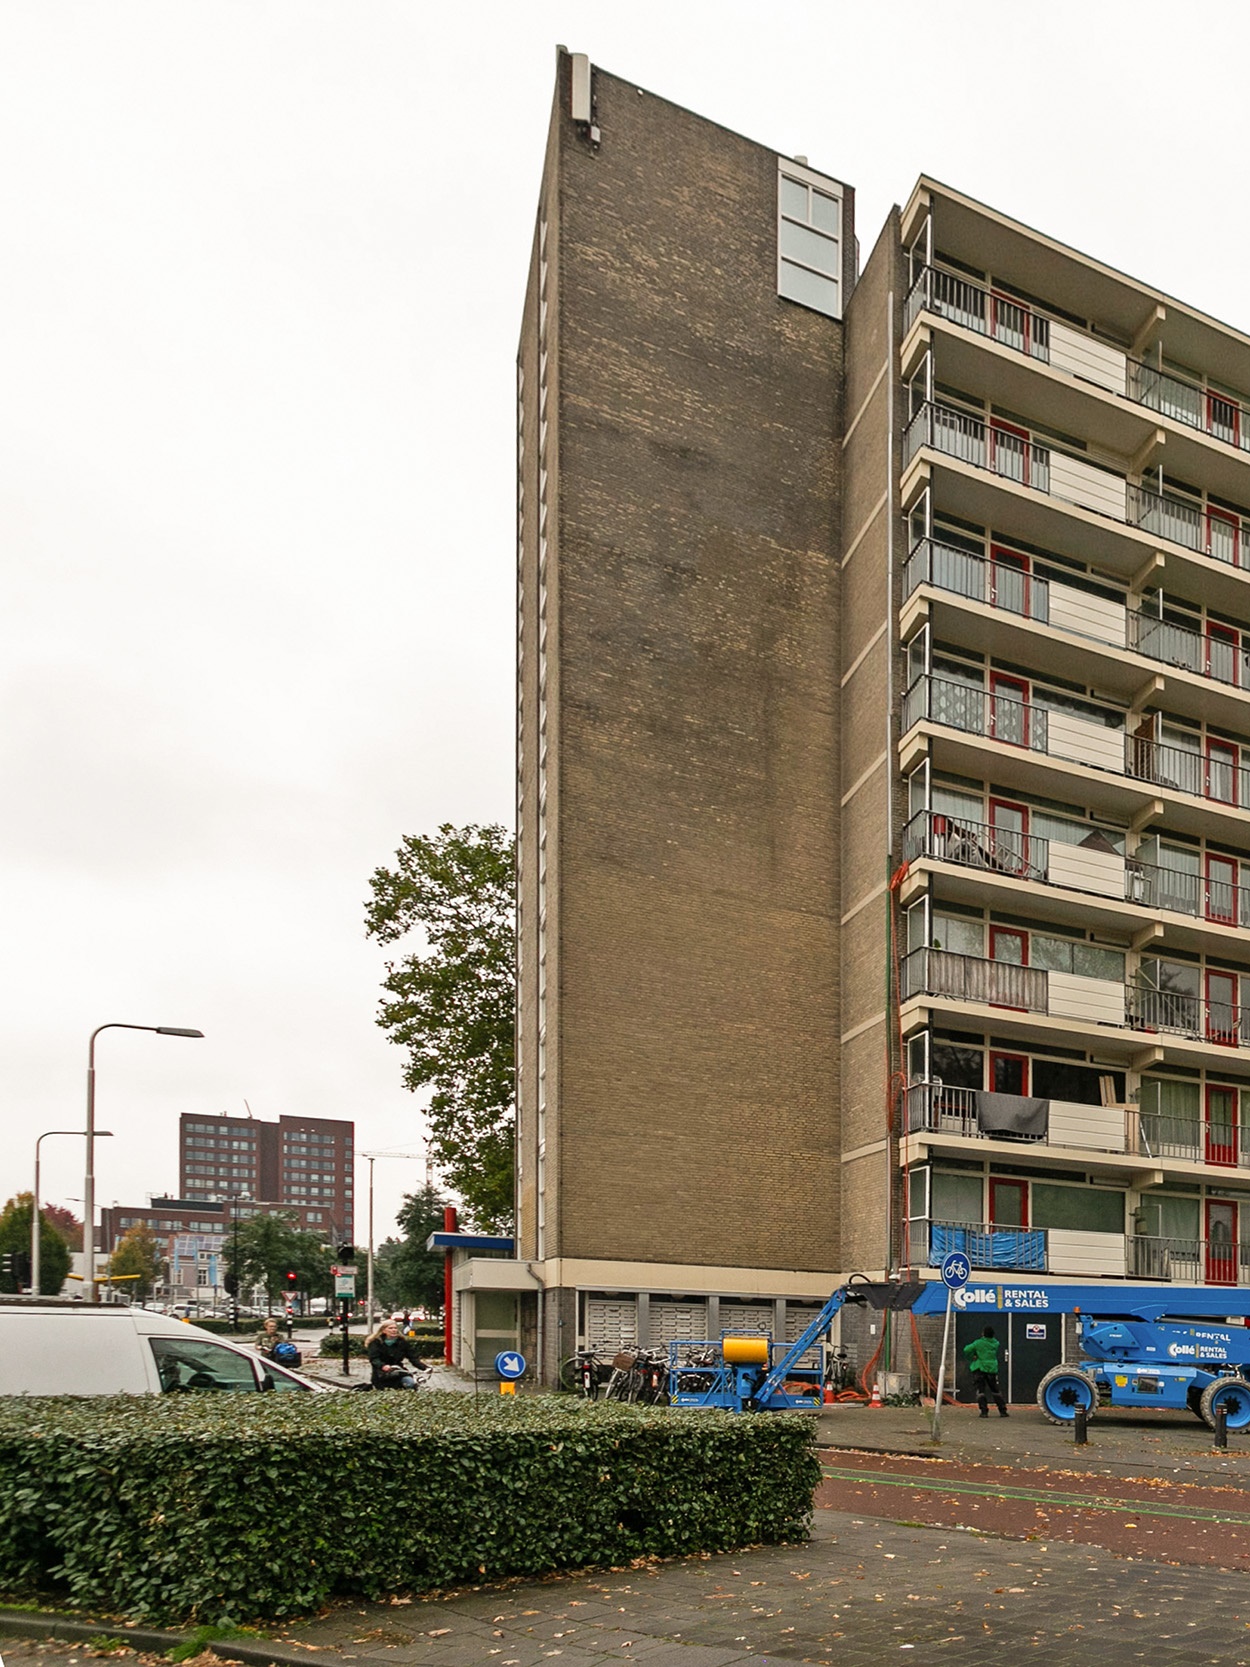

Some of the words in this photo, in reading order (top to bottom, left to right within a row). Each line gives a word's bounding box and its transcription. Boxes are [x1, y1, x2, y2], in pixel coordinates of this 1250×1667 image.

[954, 1287, 996, 1307] Collé
[1004, 1290, 1049, 1299] RENTAL
[1004, 1299, 1013, 1308] &
[1014, 1299, 1049, 1308] SALES
[1168, 1343, 1195, 1358] Collé
